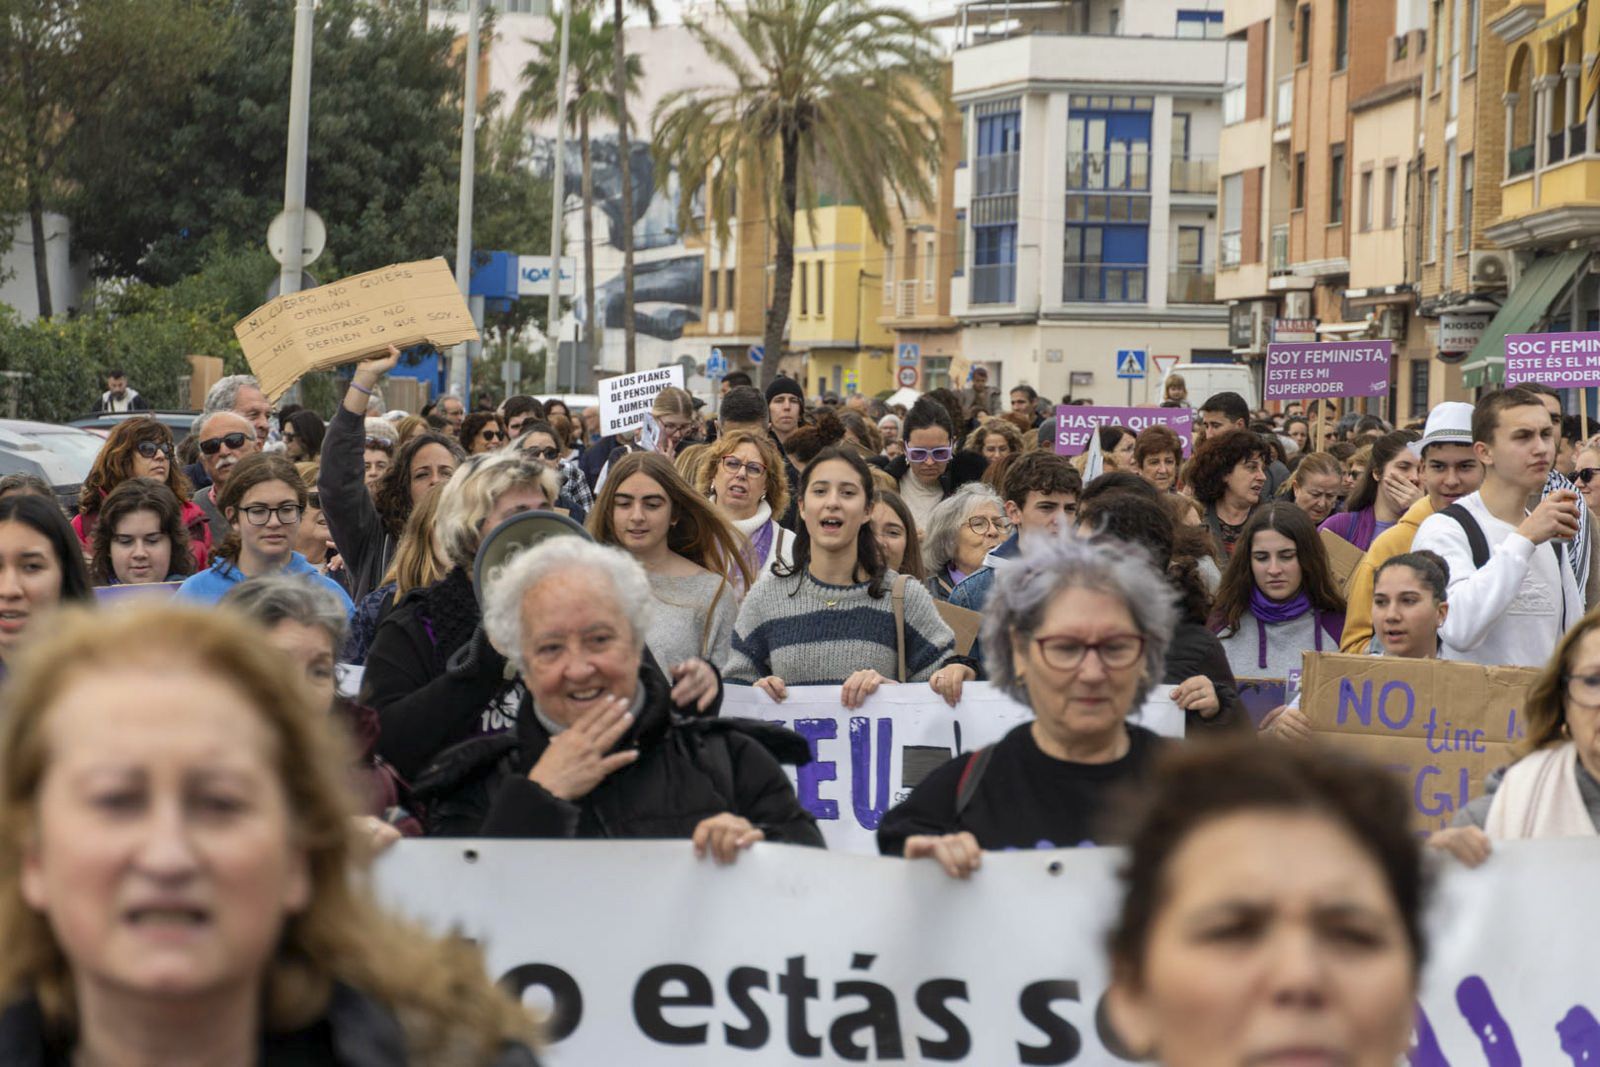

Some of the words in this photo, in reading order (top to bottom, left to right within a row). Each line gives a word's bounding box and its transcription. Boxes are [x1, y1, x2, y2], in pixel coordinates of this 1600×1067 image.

[328, 286, 347, 298] NO
[359, 269, 413, 289] QUIERE
[305, 315, 371, 336] GENITALES
[383, 305, 405, 318] NO
[1444, 321, 1485, 330] KIOSCO
[306, 332, 361, 351] DEFINEN
[370, 324, 385, 335] LO
[396, 316, 417, 328] QUE
[1444, 336, 1480, 345] PRENS
[1508, 341, 1546, 355] SOC
[1271, 351, 1301, 365] SOY
[1304, 348, 1388, 363] FEMINISTA,
[1508, 358, 1543, 369] ESTE
[1546, 354, 1562, 368] ÉS
[1566, 357, 1583, 367] EL
[619, 376, 635, 388] LOS
[637, 370, 671, 384] PLANES
[1269, 369, 1297, 380] ESTE
[1300, 368, 1314, 379] ES
[1316, 368, 1330, 378] MI
[1508, 370, 1600, 383] SUPERPODER
[1268, 382, 1344, 395] SUPERPODER
[611, 392, 622, 402] DE
[618, 398, 654, 414] AUMENT
[610, 418, 622, 429] DE
[1060, 415, 1122, 428] HASTA
[1128, 417, 1167, 432] QUE
[1059, 432, 1091, 446] SEA
[1336, 677, 1415, 730] NO
[1422, 707, 1486, 754] tinc
[632, 952, 972, 1063] estás
